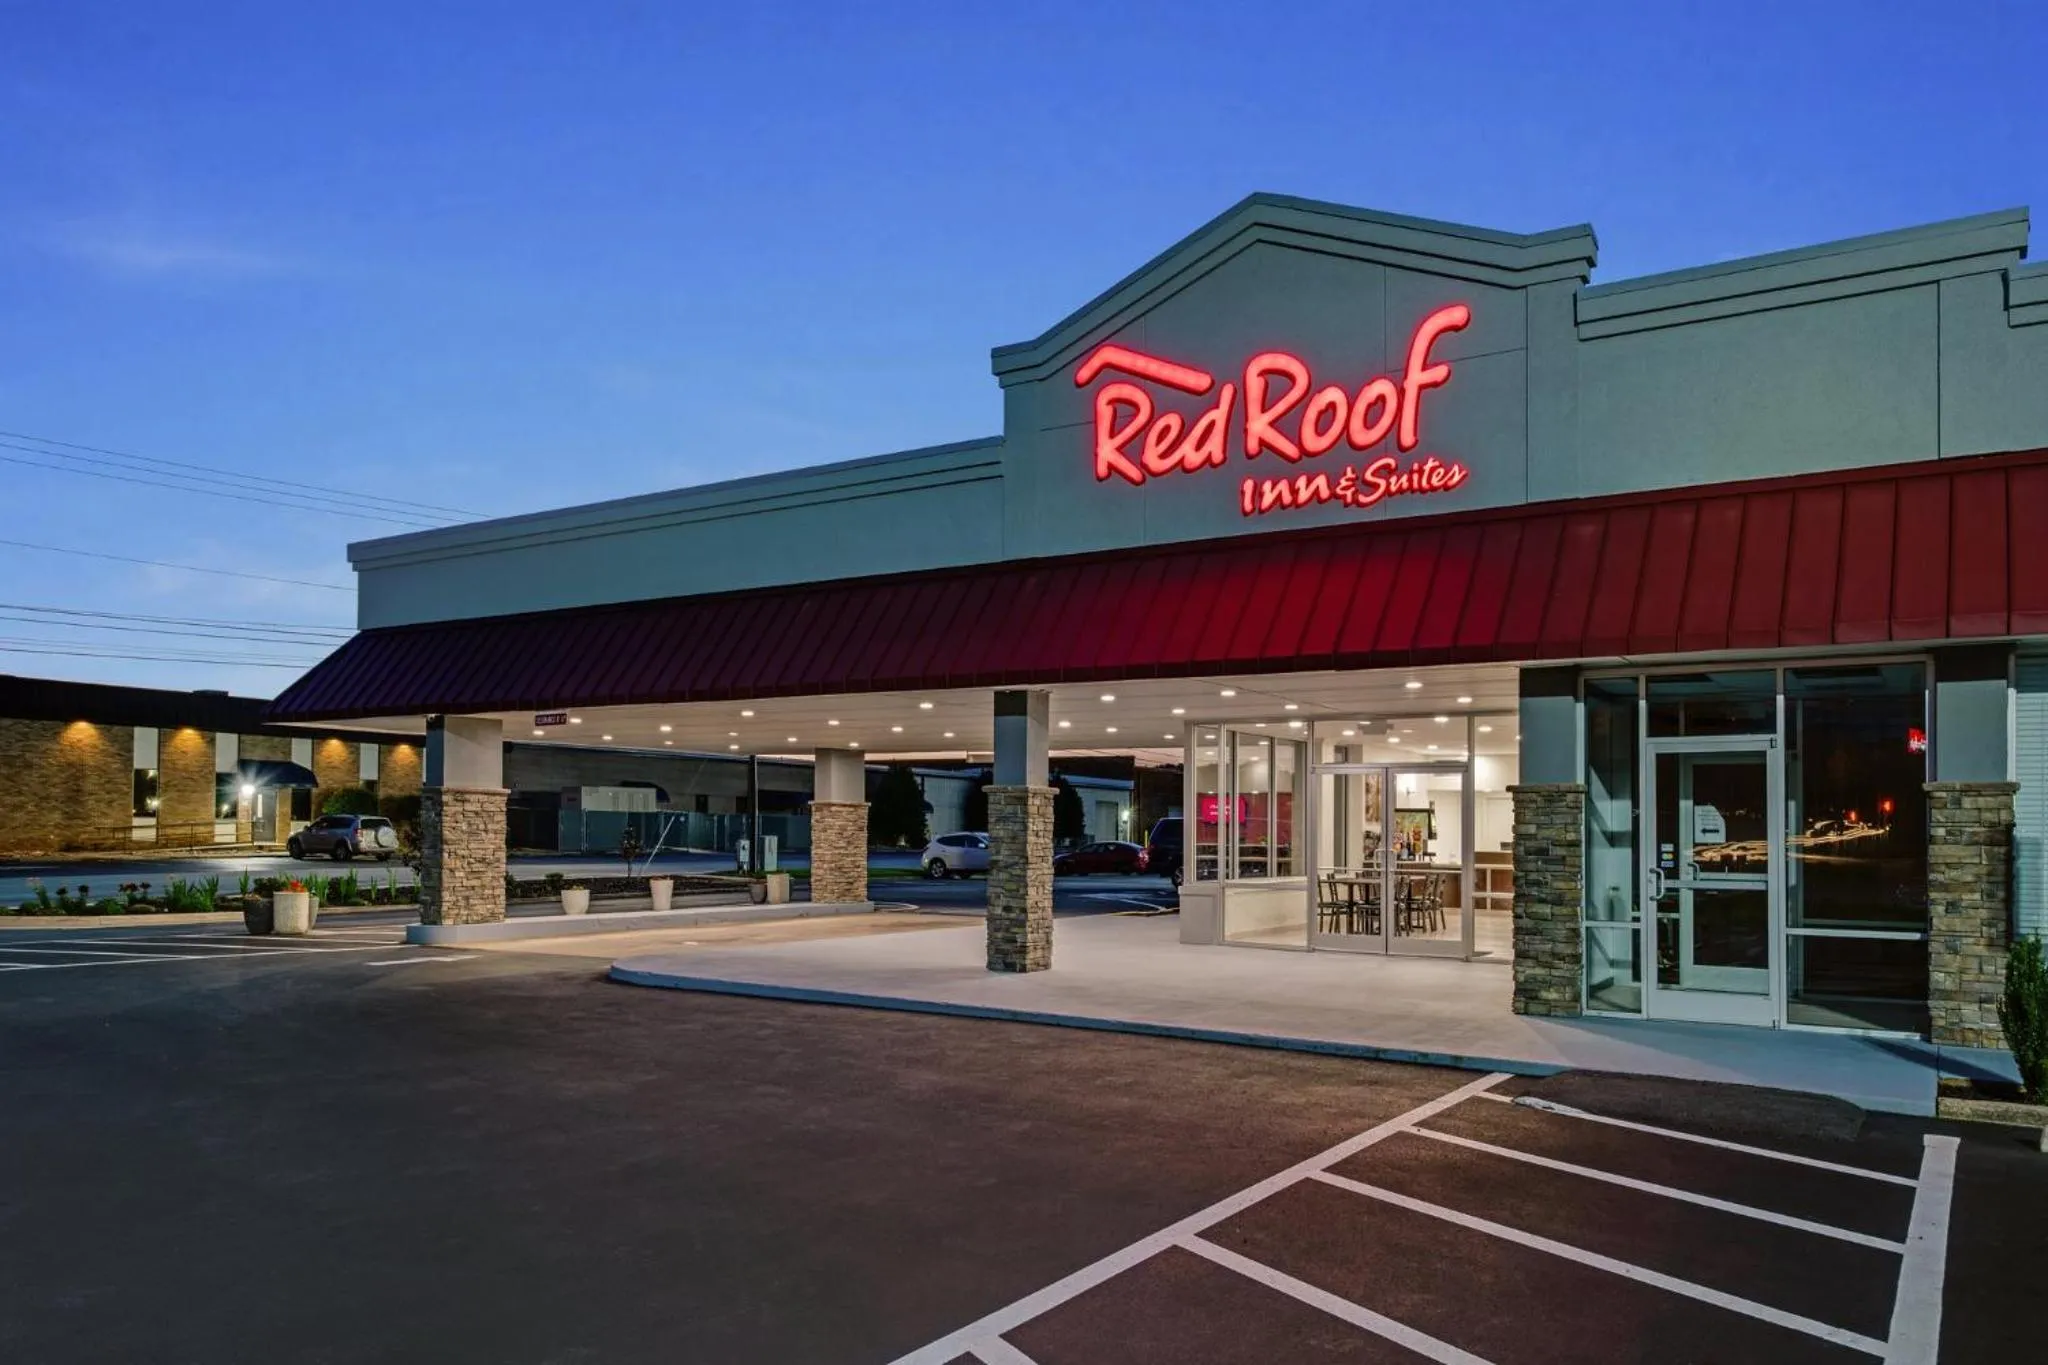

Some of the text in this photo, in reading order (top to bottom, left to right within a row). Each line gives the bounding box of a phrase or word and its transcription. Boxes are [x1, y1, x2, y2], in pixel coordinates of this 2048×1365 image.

[1096, 304, 1471, 486] Red Roof
[1241, 456, 1468, 516] Inn & Suites
